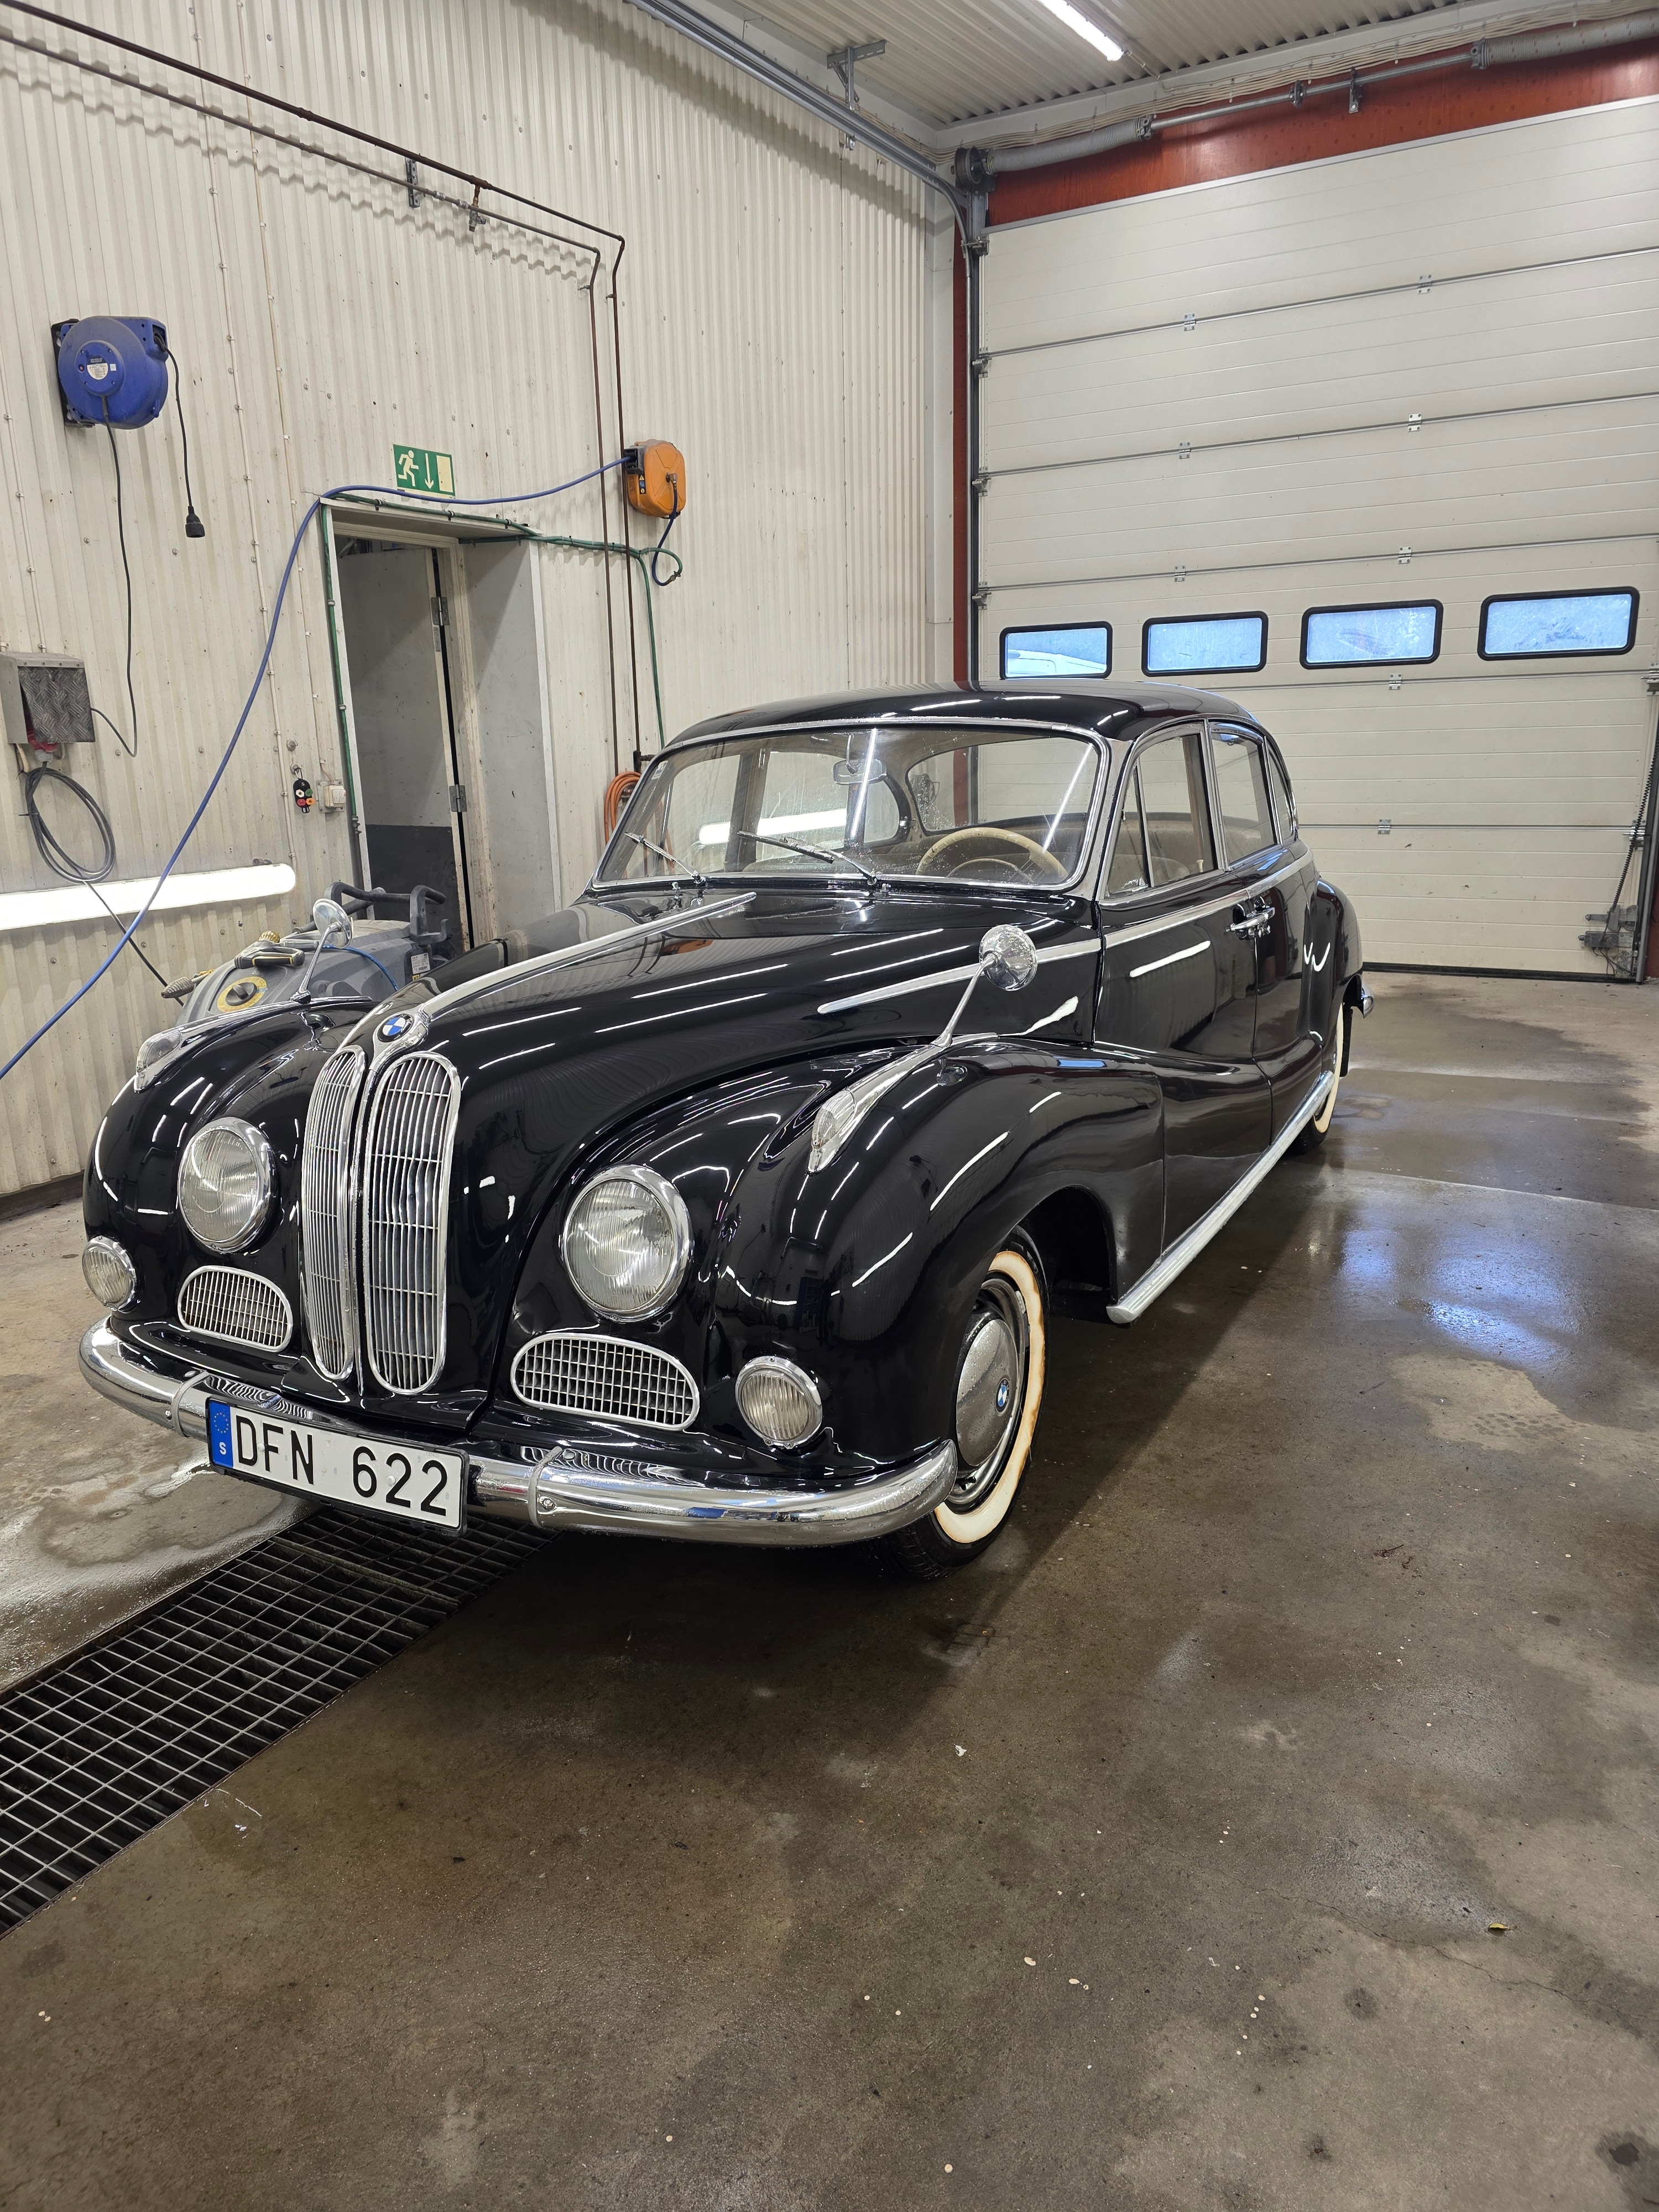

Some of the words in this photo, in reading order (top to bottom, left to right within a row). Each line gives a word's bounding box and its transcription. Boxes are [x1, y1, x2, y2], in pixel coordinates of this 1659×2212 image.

[219, 1442, 227, 1455] S
[236, 1415, 314, 1485] DFN
[353, 1446, 448, 1516] 622
